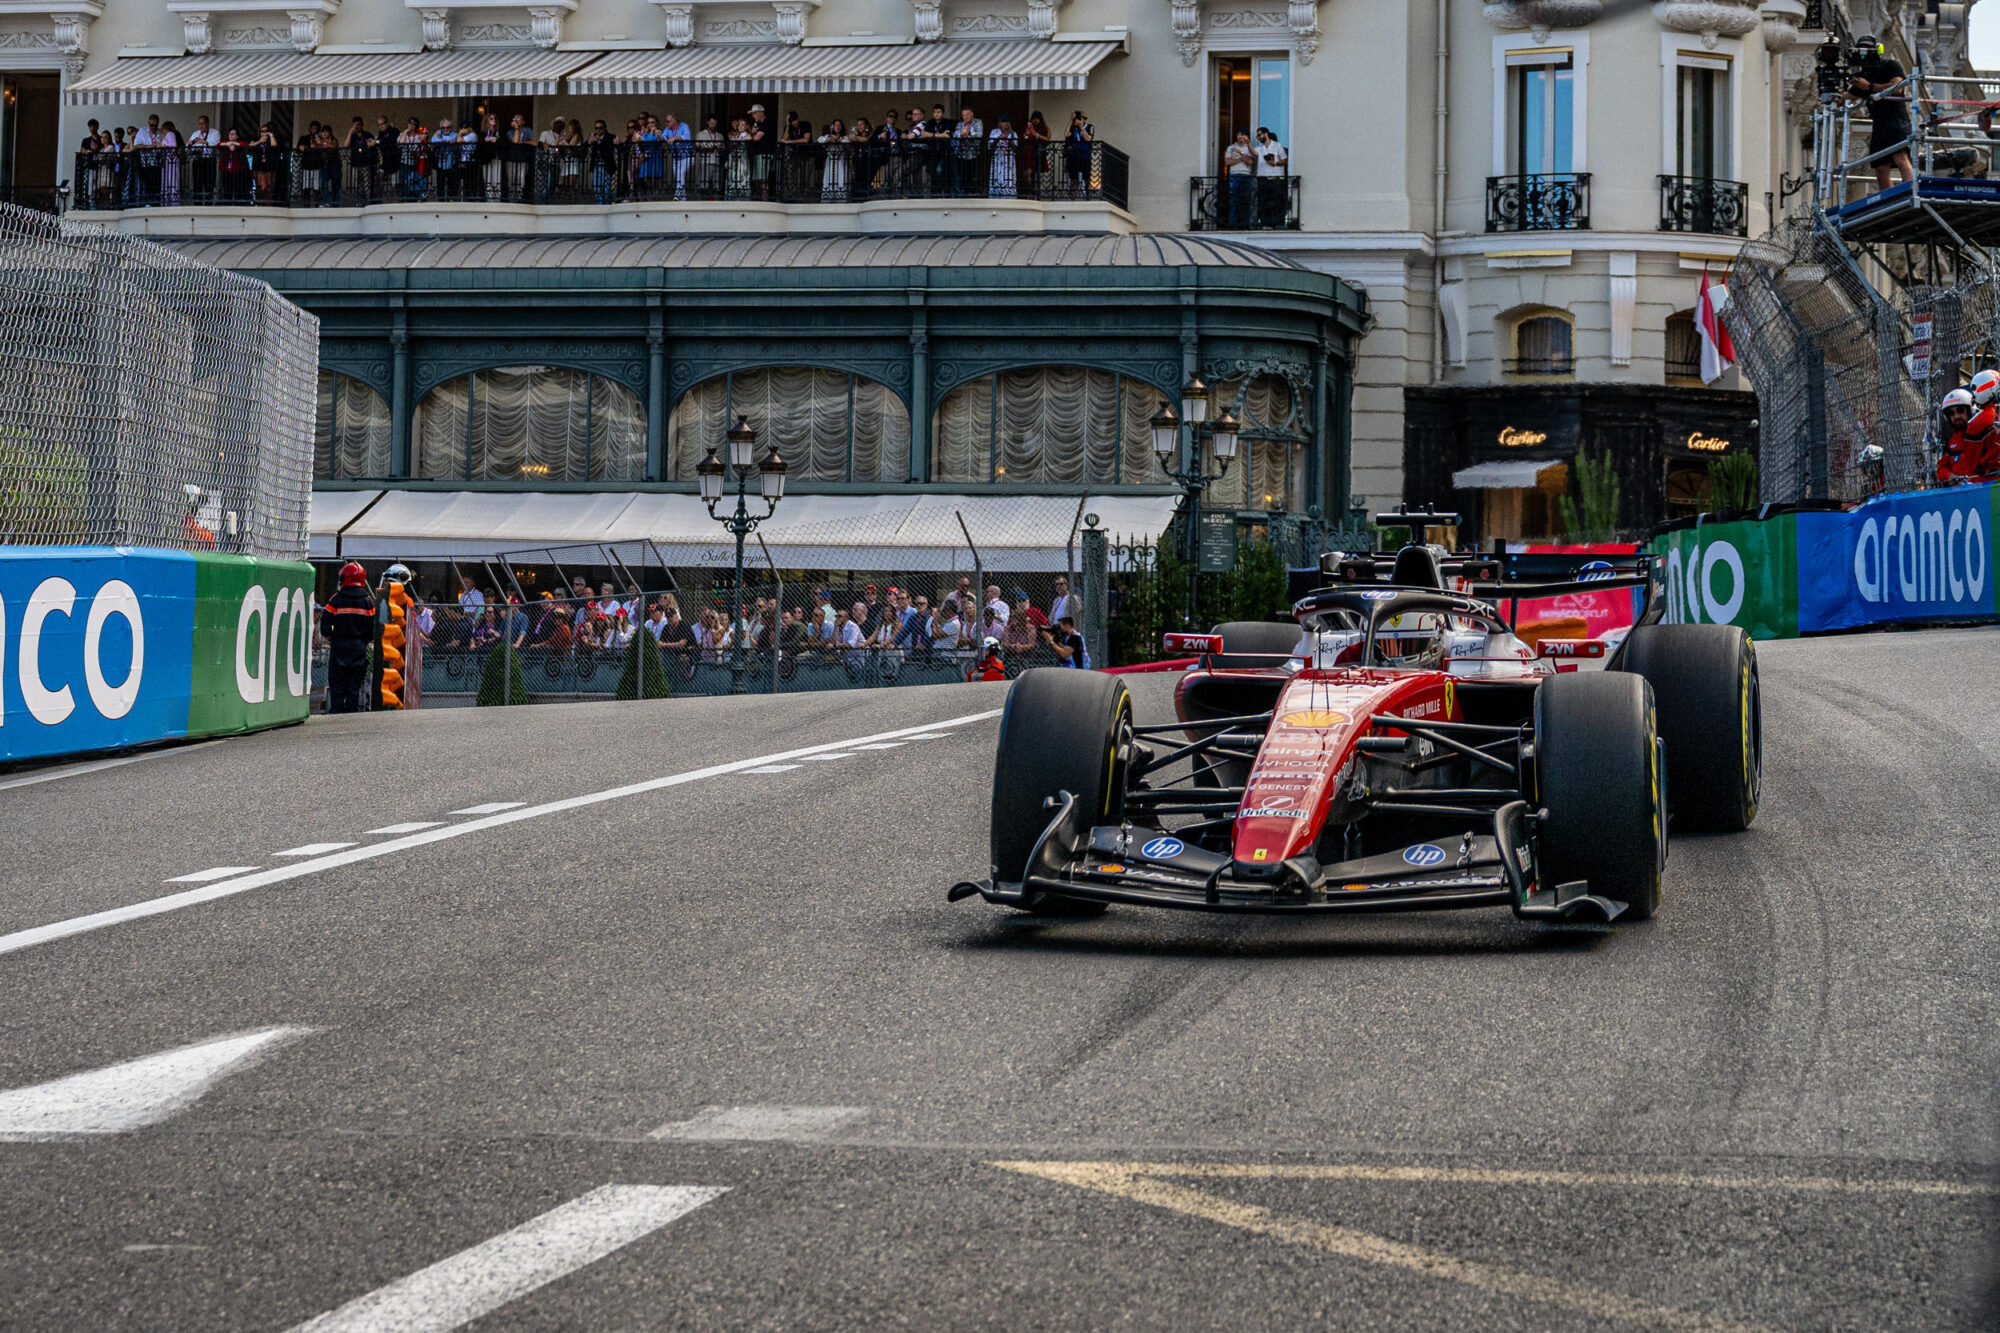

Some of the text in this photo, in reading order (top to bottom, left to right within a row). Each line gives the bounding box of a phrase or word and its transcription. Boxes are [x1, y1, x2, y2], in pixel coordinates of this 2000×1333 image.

[1687, 431, 1730, 450] Cartier
[1854, 507, 1985, 602] aramco
[1658, 540, 1745, 624] mco
[1452, 598, 1495, 620] DXC
[0, 576, 145, 728] co
[1183, 638, 1208, 650] ZYN
[1451, 641, 1484, 656] Ray-Ban
[1545, 643, 1575, 655] ZYN
[1258, 783, 1317, 792] GENESYS
[1240, 807, 1309, 820] UniCredit
[1144, 837, 1182, 858] hp
[1406, 844, 1442, 866] hp
